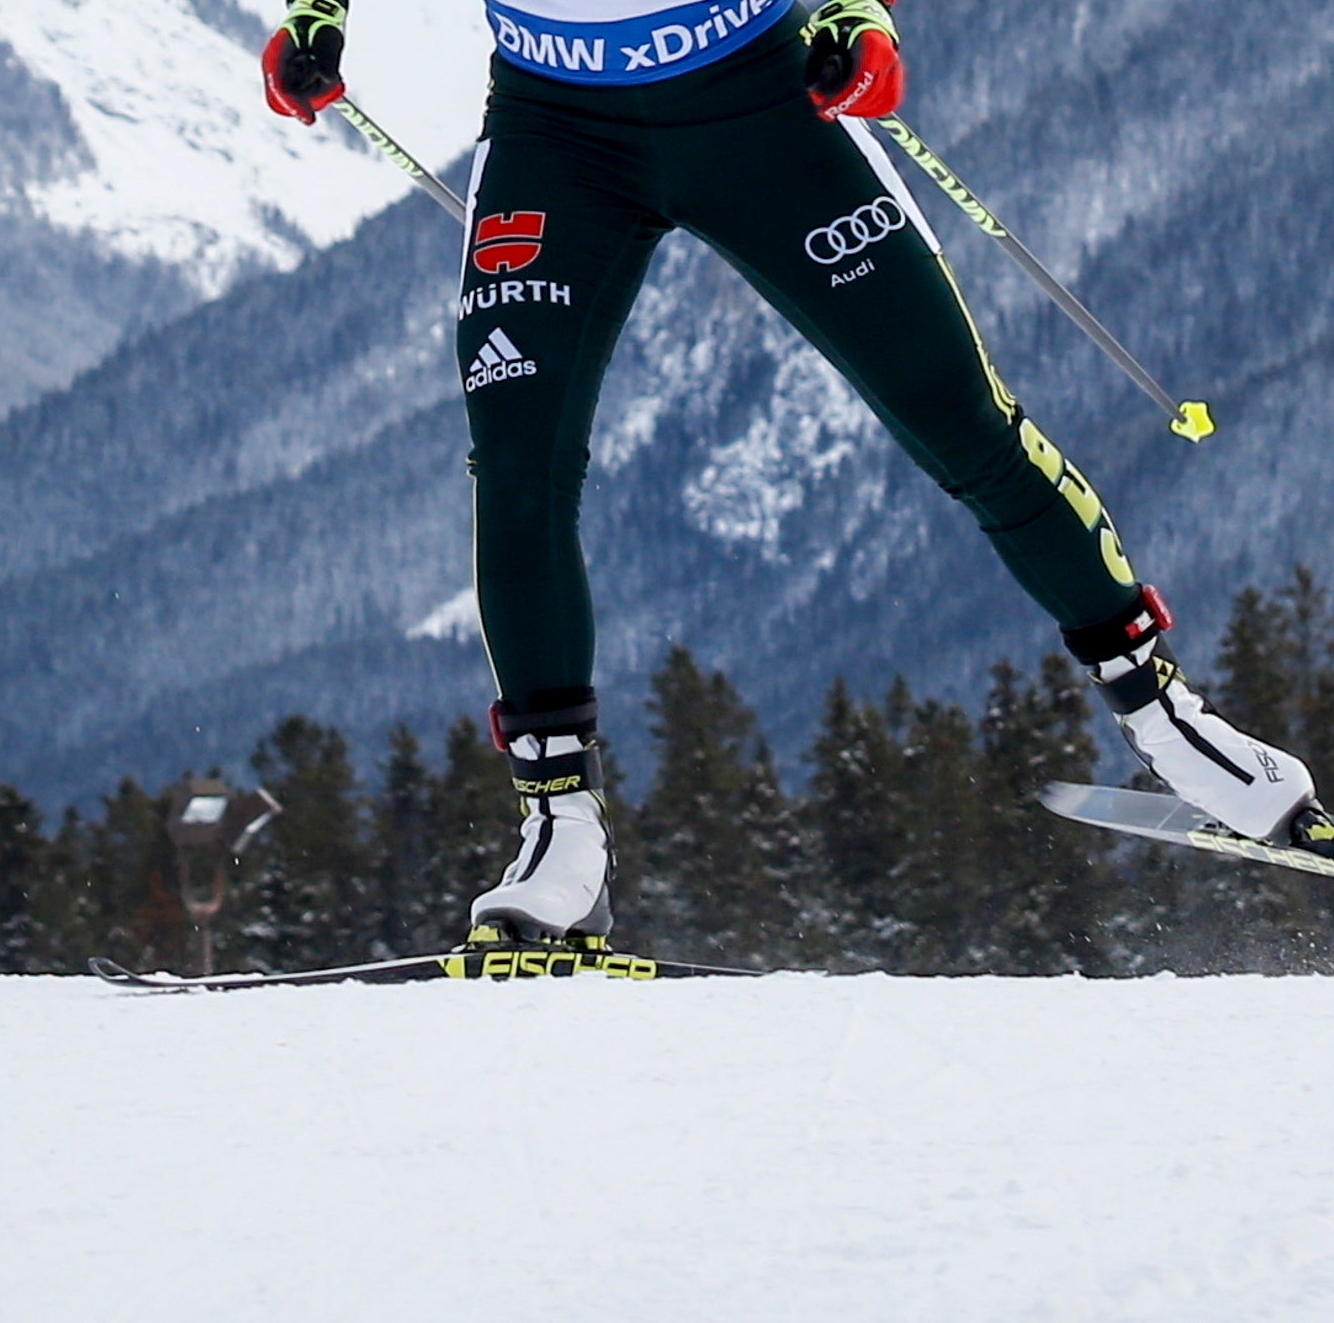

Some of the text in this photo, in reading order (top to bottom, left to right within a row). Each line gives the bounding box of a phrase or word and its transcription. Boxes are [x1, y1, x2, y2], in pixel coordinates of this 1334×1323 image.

[492, 11, 605, 72] BMW
[830, 258, 876, 288] Audi
[459, 279, 571, 321] WÜRTH
[465, 360, 537, 392] adidas
